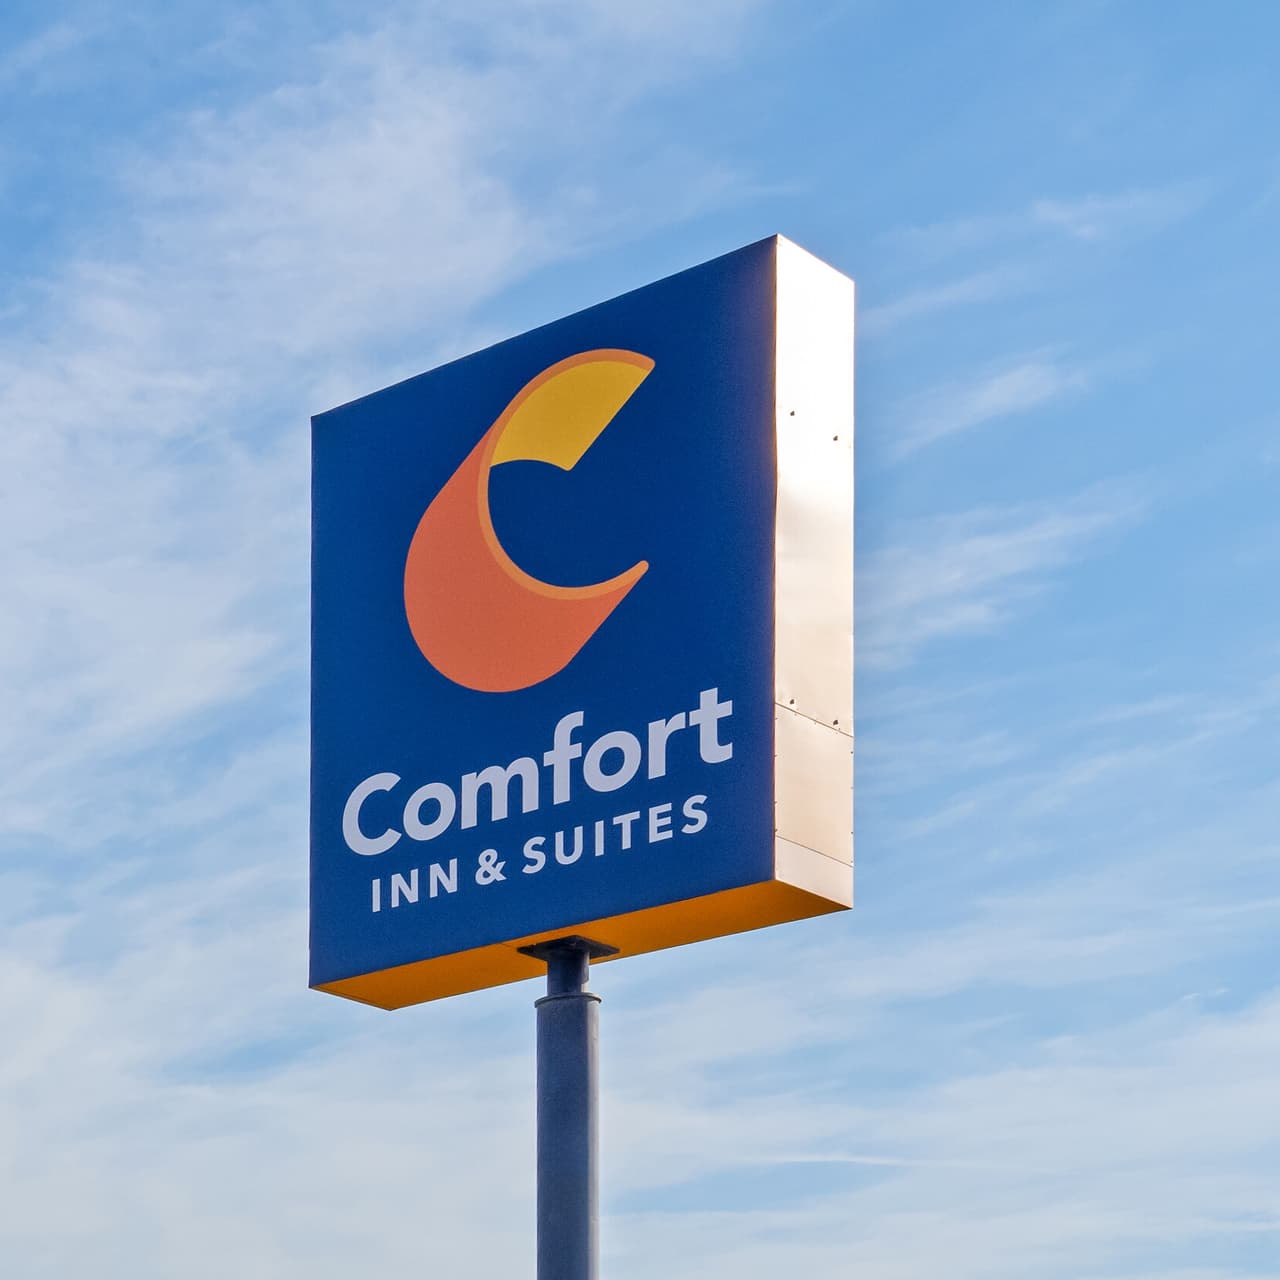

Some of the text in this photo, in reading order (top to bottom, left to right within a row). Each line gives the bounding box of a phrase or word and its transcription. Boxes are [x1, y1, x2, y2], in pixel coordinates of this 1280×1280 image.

[342, 687, 733, 856] Comfort
[372, 794, 708, 913] INN & SUITES
